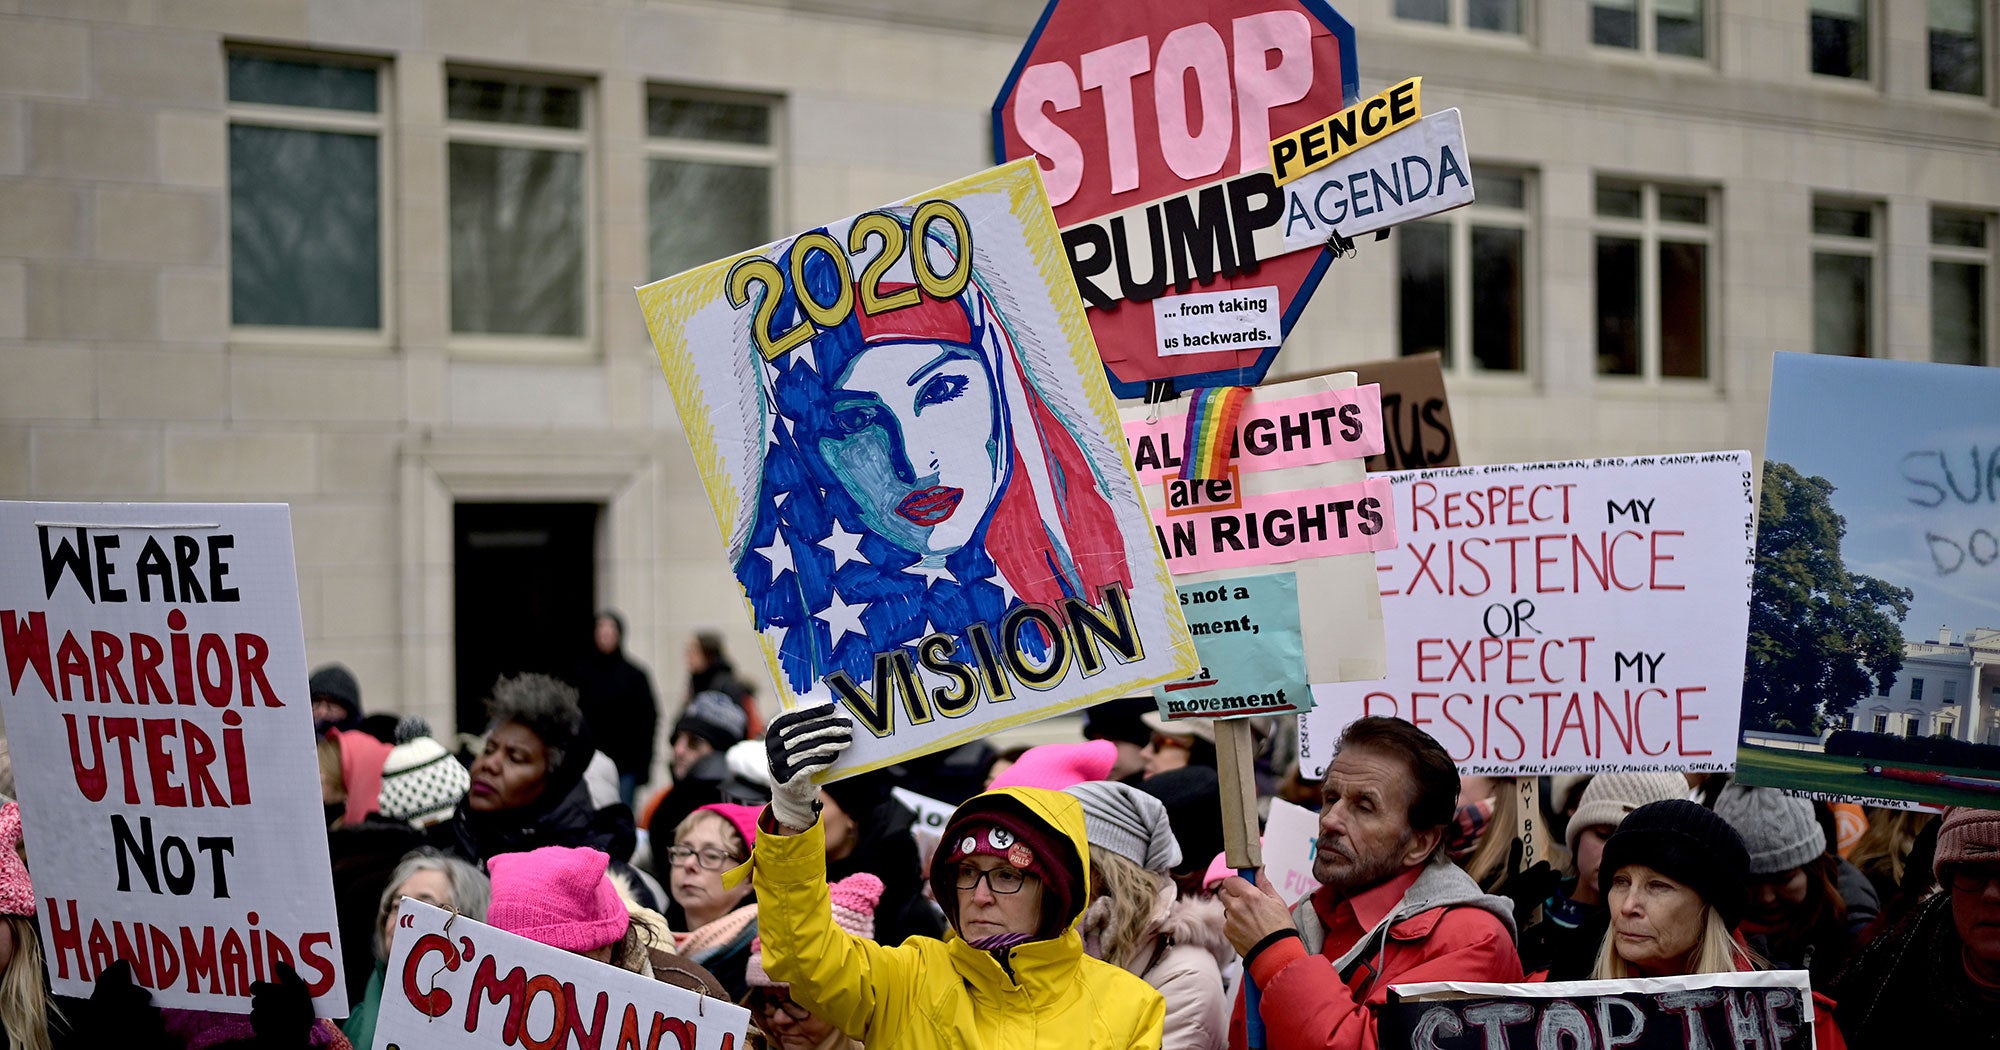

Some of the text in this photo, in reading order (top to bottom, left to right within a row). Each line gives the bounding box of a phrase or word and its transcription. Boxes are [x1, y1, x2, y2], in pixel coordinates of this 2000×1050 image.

[1014, 10, 1315, 207] STOP
[1273, 81, 1418, 182] PENCE
[1285, 144, 1470, 238] AGENDA
[1061, 172, 1286, 311] RUMP
[725, 199, 974, 363] 2020
[1180, 302, 1215, 317] from
[1218, 297, 1268, 314] taking
[1164, 327, 1273, 349] us backwards.
[1229, 403, 1364, 460] IGHTS
[1170, 478, 1233, 508] are
[1411, 481, 1657, 532] RESPECT MY
[1211, 497, 1384, 553] RIGHTS
[37, 525, 241, 604] WE ARE
[1192, 585, 1228, 604] not
[1233, 585, 1250, 601] a
[1483, 598, 1542, 638] OR
[824, 581, 1146, 739] VISION
[1416, 636, 1667, 685] EXPECT MY
[1167, 688, 1288, 713] movement
[1472, 765, 1517, 775] DRAGON,
[1519, 763, 1548, 775] FILLY,
[1689, 761, 1728, 773] SHEILA,
[1520, 781, 1534, 870] MY BODY
[110, 814, 235, 899] NOT
